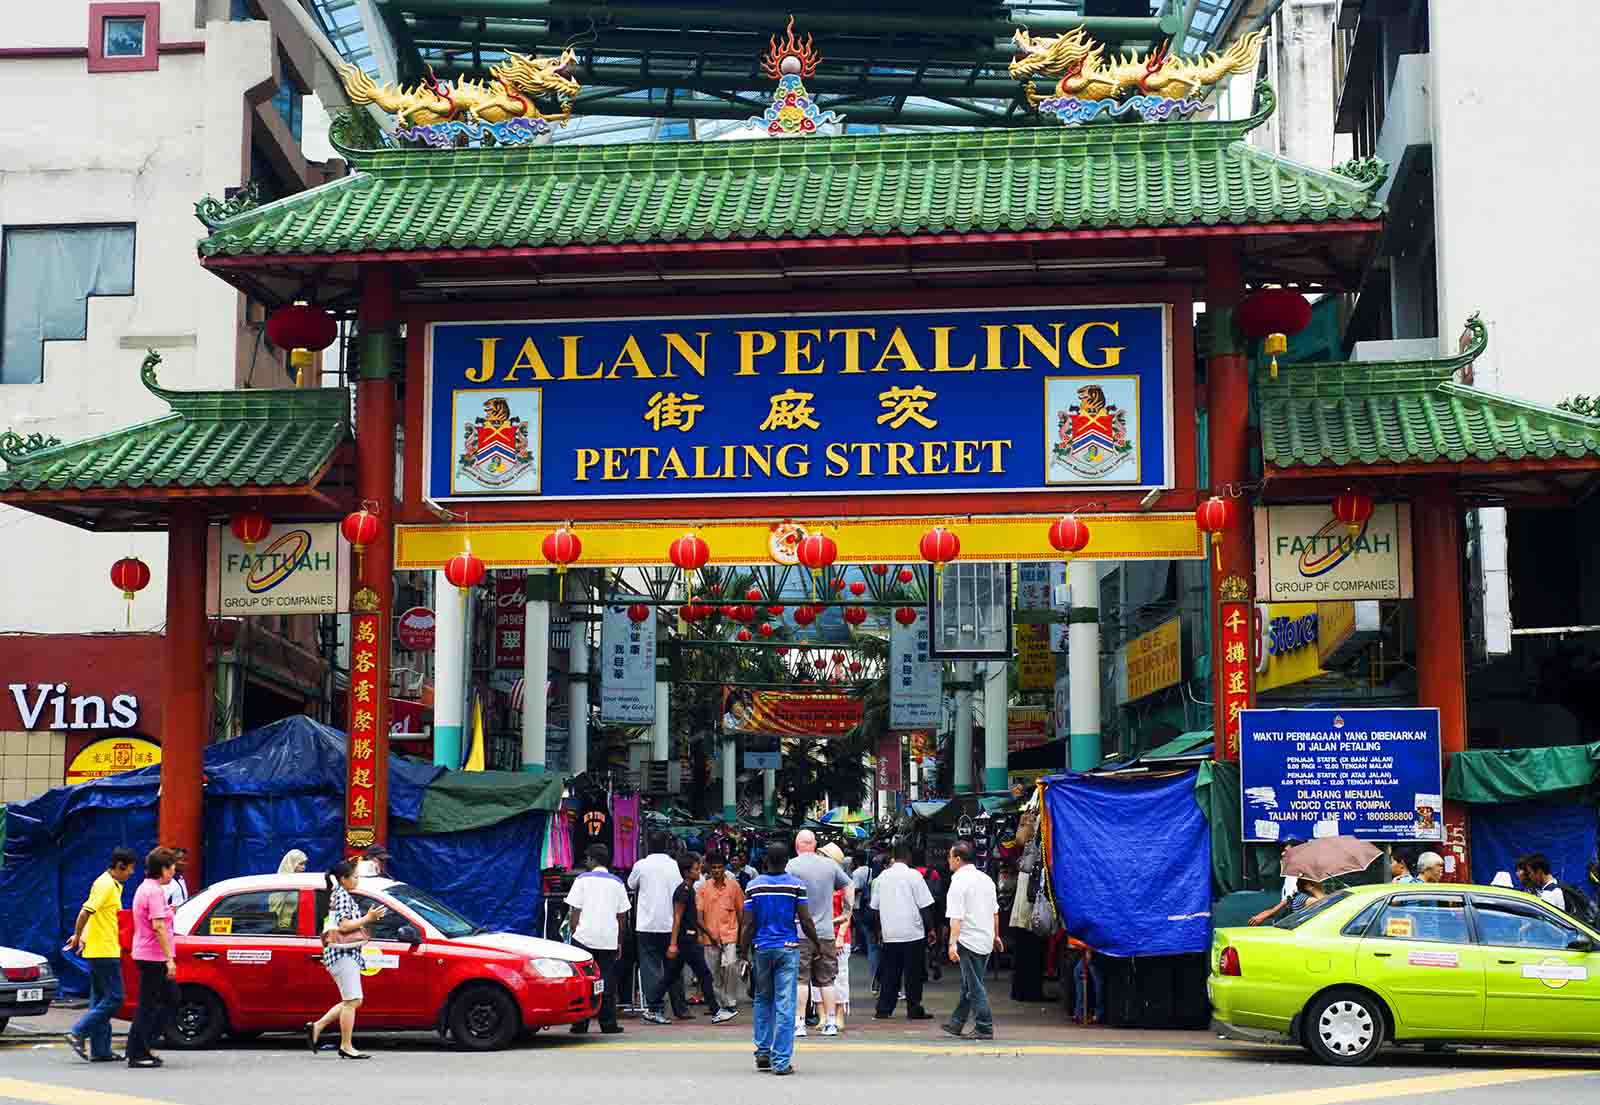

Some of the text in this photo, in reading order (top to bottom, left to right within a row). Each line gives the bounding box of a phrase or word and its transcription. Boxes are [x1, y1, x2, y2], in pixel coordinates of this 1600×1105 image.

[464, 320, 1127, 382] JALAN PETALING
[573, 440, 1012, 481] PETALING STREET
[1277, 534, 1391, 555] FATTUAH
[227, 552, 331, 573] FATTUAH
[1275, 580, 1396, 592] GROUP OF COMPANIES
[224, 594, 334, 608] GROUP OF COMPANIES
[8, 682, 138, 729] Vins
[1253, 731, 1427, 741] WAKTU PERNIAGAAN YANG DIBENARKAN
[1296, 742, 1381, 751] DI JALAN PETALING
[1297, 790, 1384, 799] DILARANG MENJUAL
[1290, 801, 1391, 810] VCD/CD CETAK ROMPAK
[1268, 812, 1298, 821] TALIAN
[1301, 812, 1319, 820] HOT
[1322, 812, 1340, 820] LINE
[1344, 812, 1357, 820] NO
